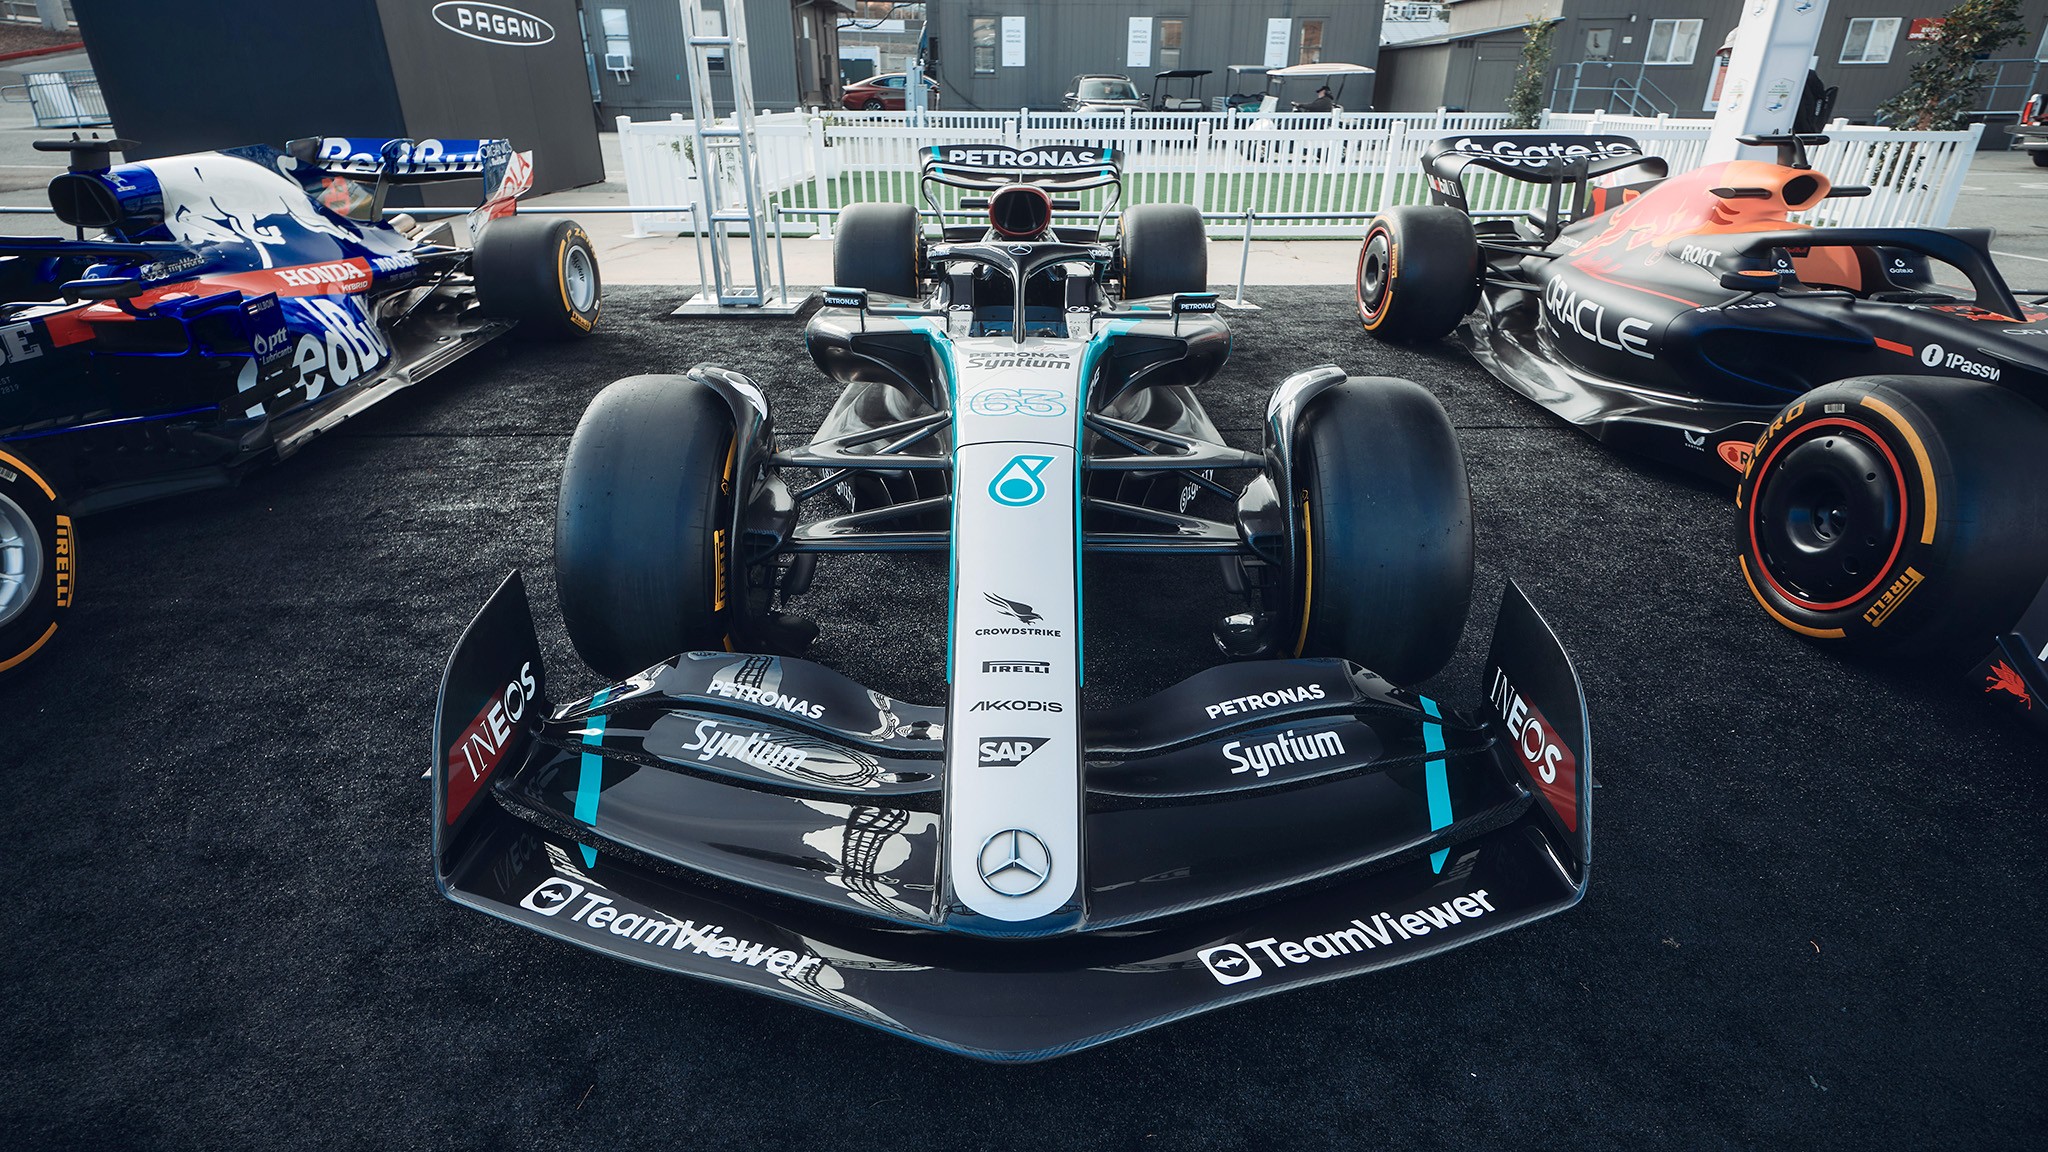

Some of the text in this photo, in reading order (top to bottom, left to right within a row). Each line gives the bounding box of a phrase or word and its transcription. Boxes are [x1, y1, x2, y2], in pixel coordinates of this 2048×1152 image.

[457, 7, 541, 40] PAGANI
[411, 138, 504, 174] Bul
[480, 139, 513, 159] ORGANICS
[948, 149, 1097, 167] PETRONAS
[1492, 140, 1636, 168] Gate.io
[371, 252, 420, 273] MOOSE
[1679, 244, 1723, 268] ROKT
[274, 262, 366, 288] HONDA
[1889, 267, 1914, 275] Gate.io
[341, 280, 368, 293] HYBRID
[823, 296, 861, 307] PETRONAS
[1180, 301, 1216, 311] PETRONAS
[1546, 273, 1655, 360] ORACLE
[268, 326, 288, 352] ptt
[262, 345, 293, 366] Lubricants
[965, 357, 1071, 370] Syntium
[968, 351, 1071, 359] PETRONAS
[969, 387, 1067, 417] 63
[1745, 400, 1807, 480] ZERO
[56, 514, 76, 608] PIRELLI
[1862, 565, 1926, 628] PIRELLI
[974, 627, 1062, 638] CROWDSTRIKE
[981, 659, 1051, 674] PIRELLI
[706, 680, 827, 720] PETRONAS
[1204, 683, 1326, 720] PETRONAS
[460, 661, 536, 783] INEOS
[1489, 666, 1563, 785] INEOS
[681, 719, 809, 772] Syntium
[979, 741, 1034, 762] SAP
[1222, 729, 1346, 778] Syntium
[570, 892, 821, 979] TeamViewer
[1245, 888, 1497, 970] TeamViewer
